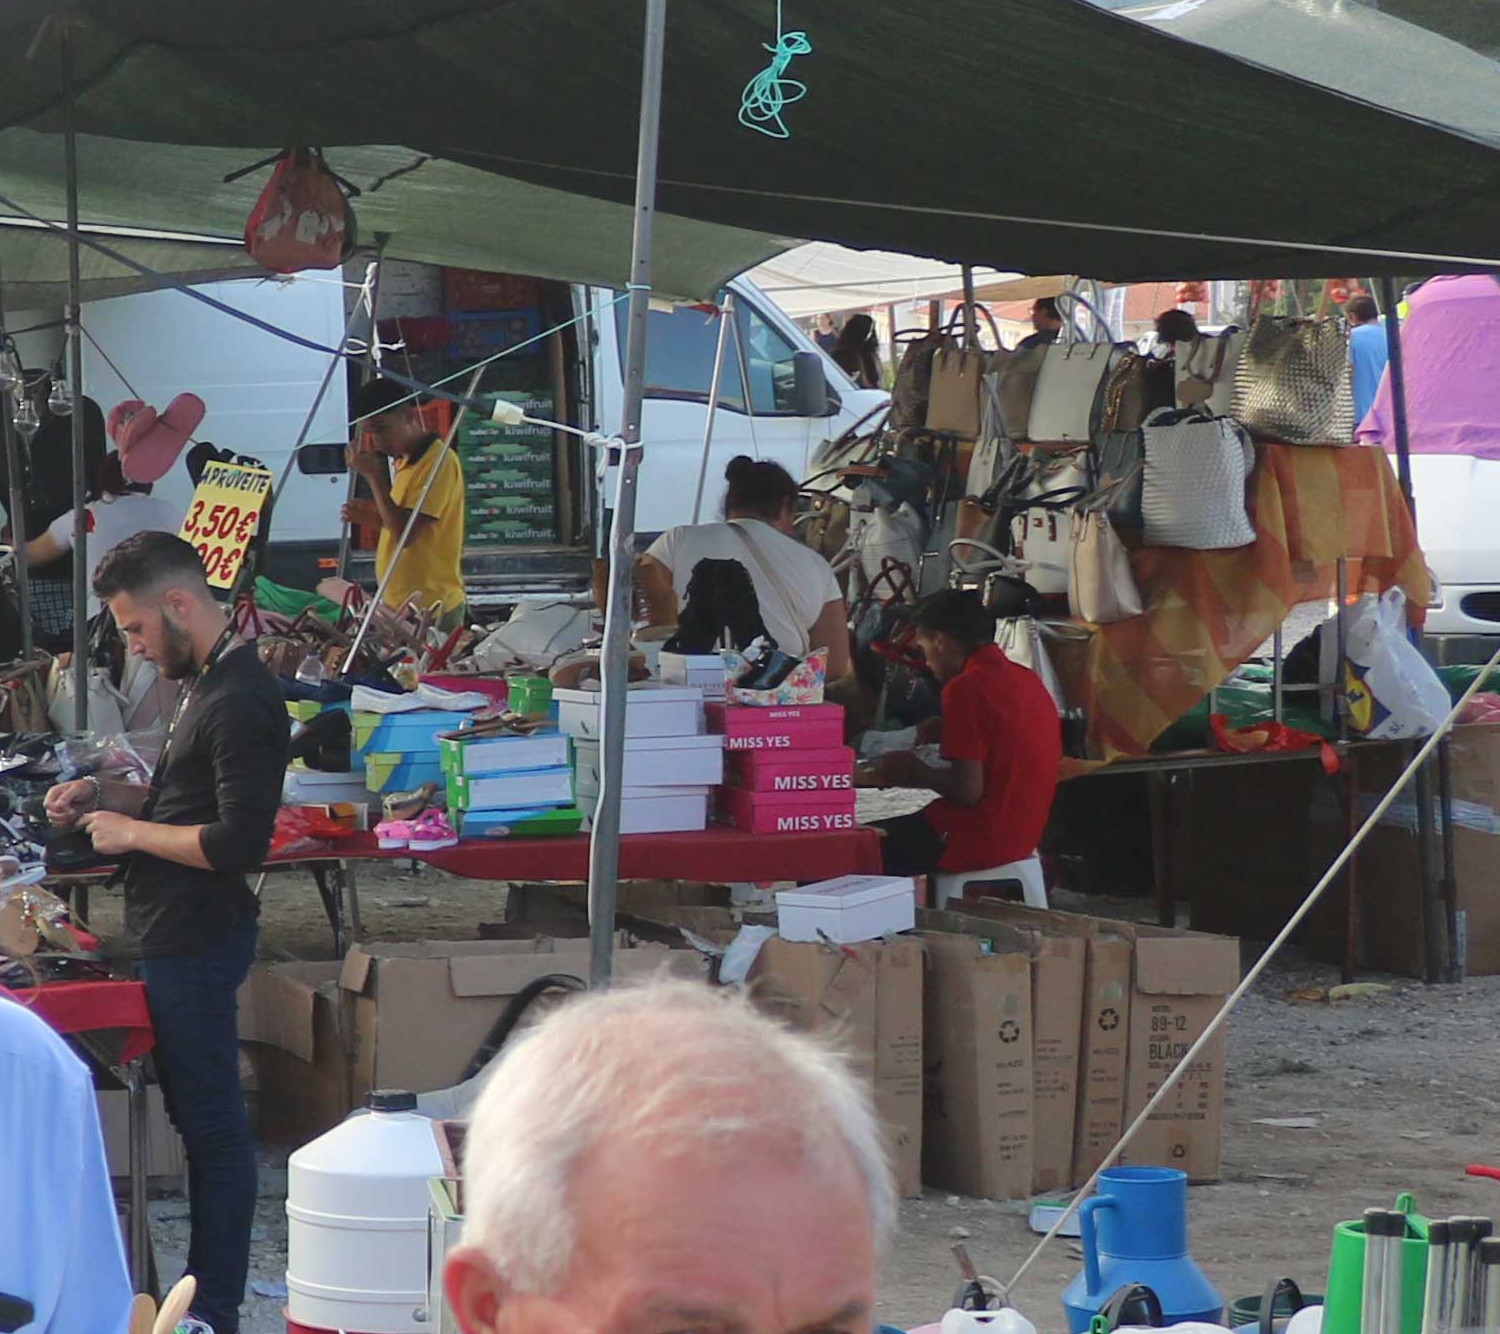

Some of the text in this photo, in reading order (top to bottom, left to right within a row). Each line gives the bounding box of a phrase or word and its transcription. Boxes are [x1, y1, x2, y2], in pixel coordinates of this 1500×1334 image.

[503, 478, 552, 489] kiwifruit
[506, 504, 553, 515] kiwifruit
[184, 500, 257, 544] 3,50€
[504, 528, 552, 540] kiwifruit
[730, 735, 790, 749] MISS YES
[774, 774, 850, 790] MISS YES
[777, 814, 852, 831] MISS YES
